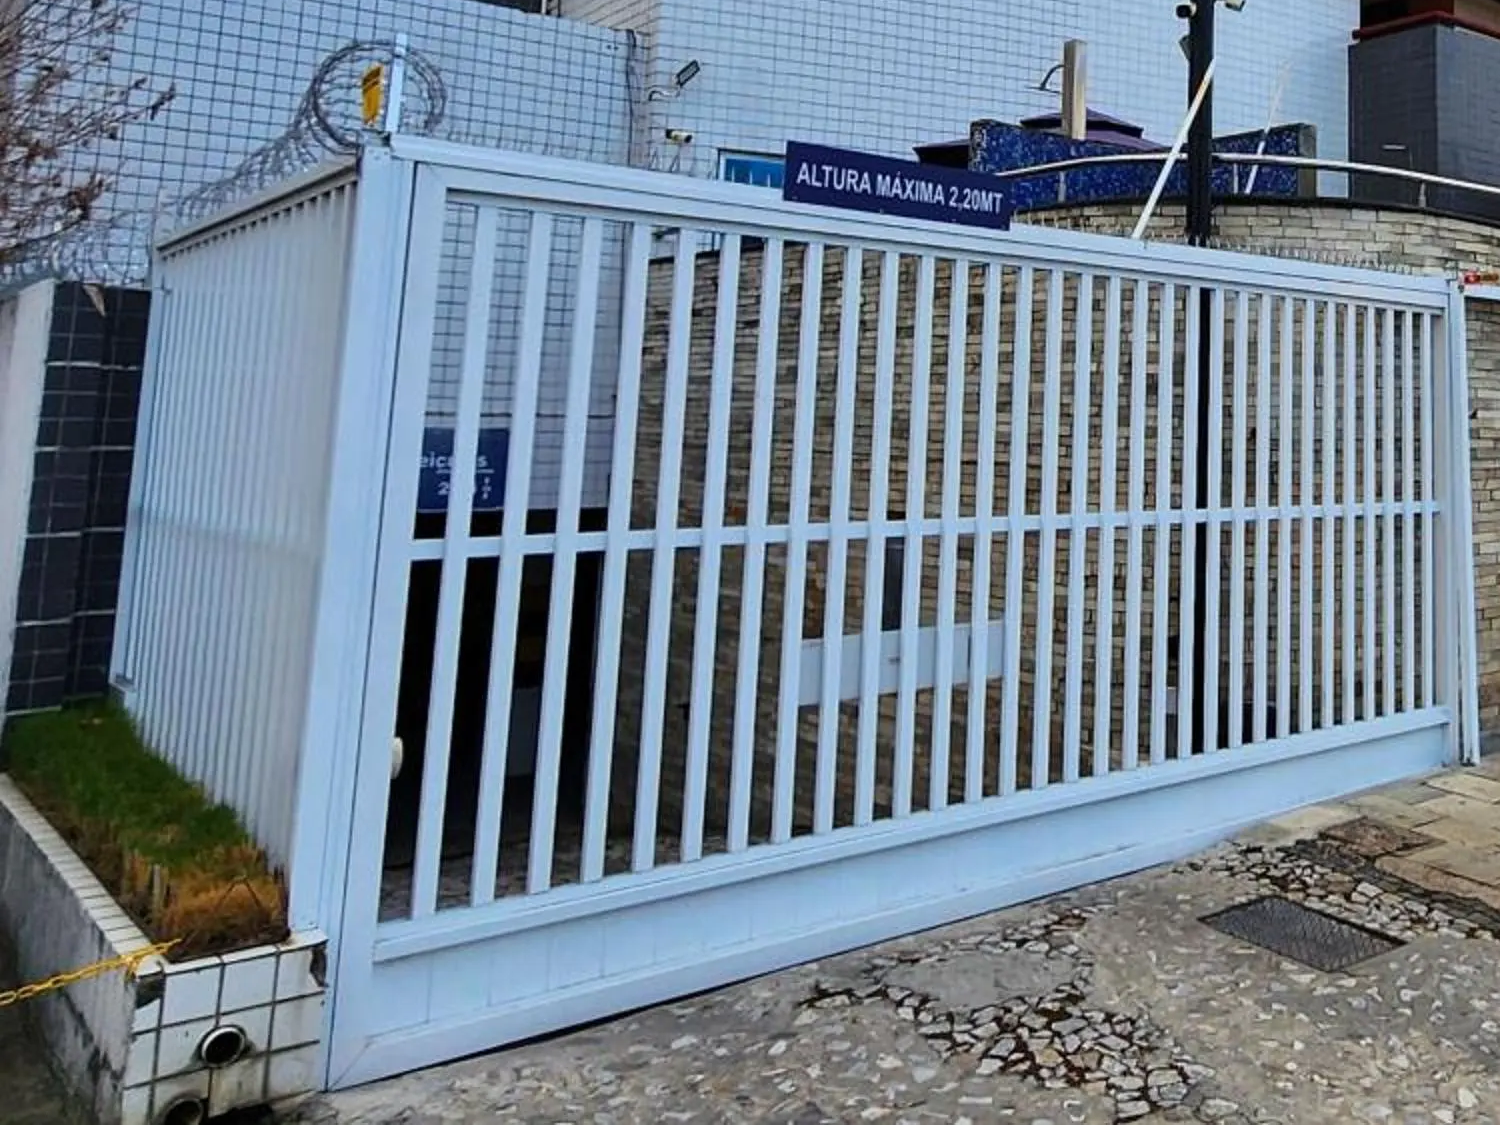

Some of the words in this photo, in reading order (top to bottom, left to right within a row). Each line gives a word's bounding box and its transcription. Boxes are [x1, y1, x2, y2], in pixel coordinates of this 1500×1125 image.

[796, 161, 871, 195] ALTURA
[876, 170, 945, 206] MÁXIMA
[949, 186, 1003, 214] 2,20MT
